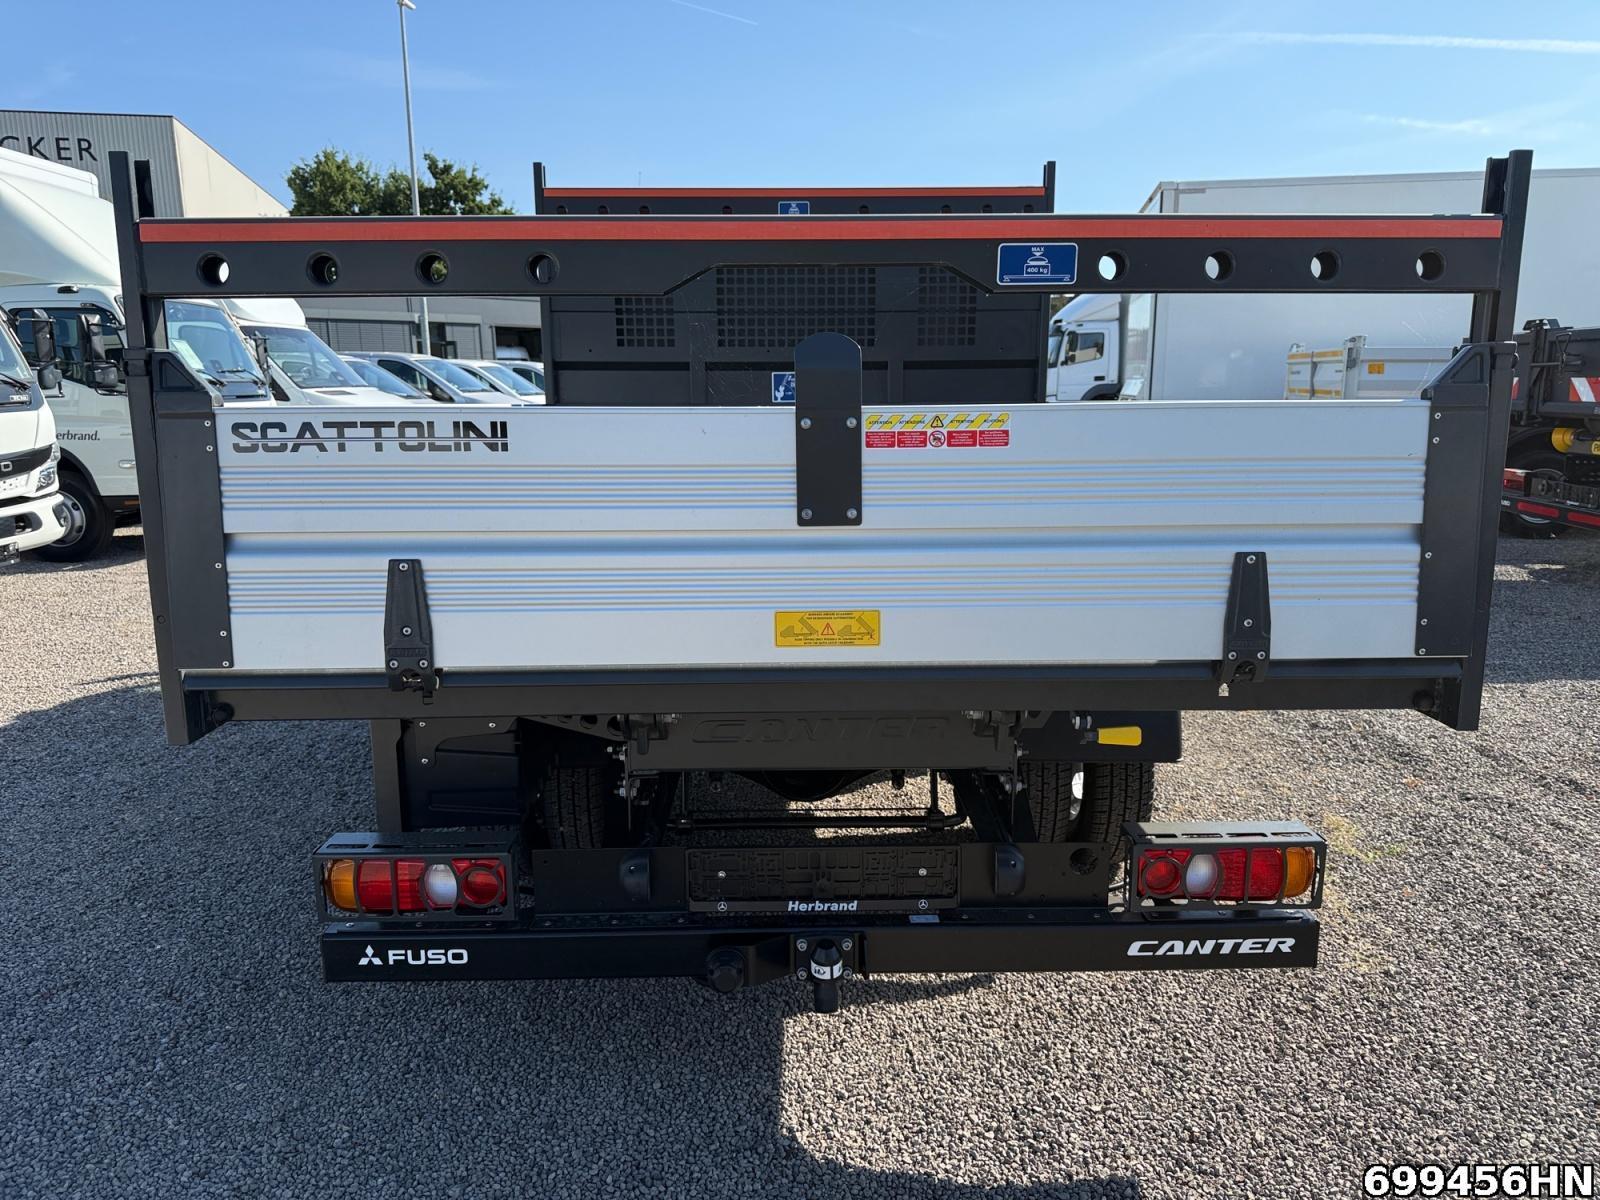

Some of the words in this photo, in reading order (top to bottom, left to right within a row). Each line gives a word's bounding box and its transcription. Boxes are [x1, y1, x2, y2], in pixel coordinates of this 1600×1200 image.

[55, 430, 101, 441] erbrand.
[231, 420, 509, 453] SCATTOLINI
[692, 717, 950, 743] CANTER
[787, 900, 858, 911] Herbrand
[1127, 937, 1296, 956] CANTER
[387, 949, 469, 965] FUSO
